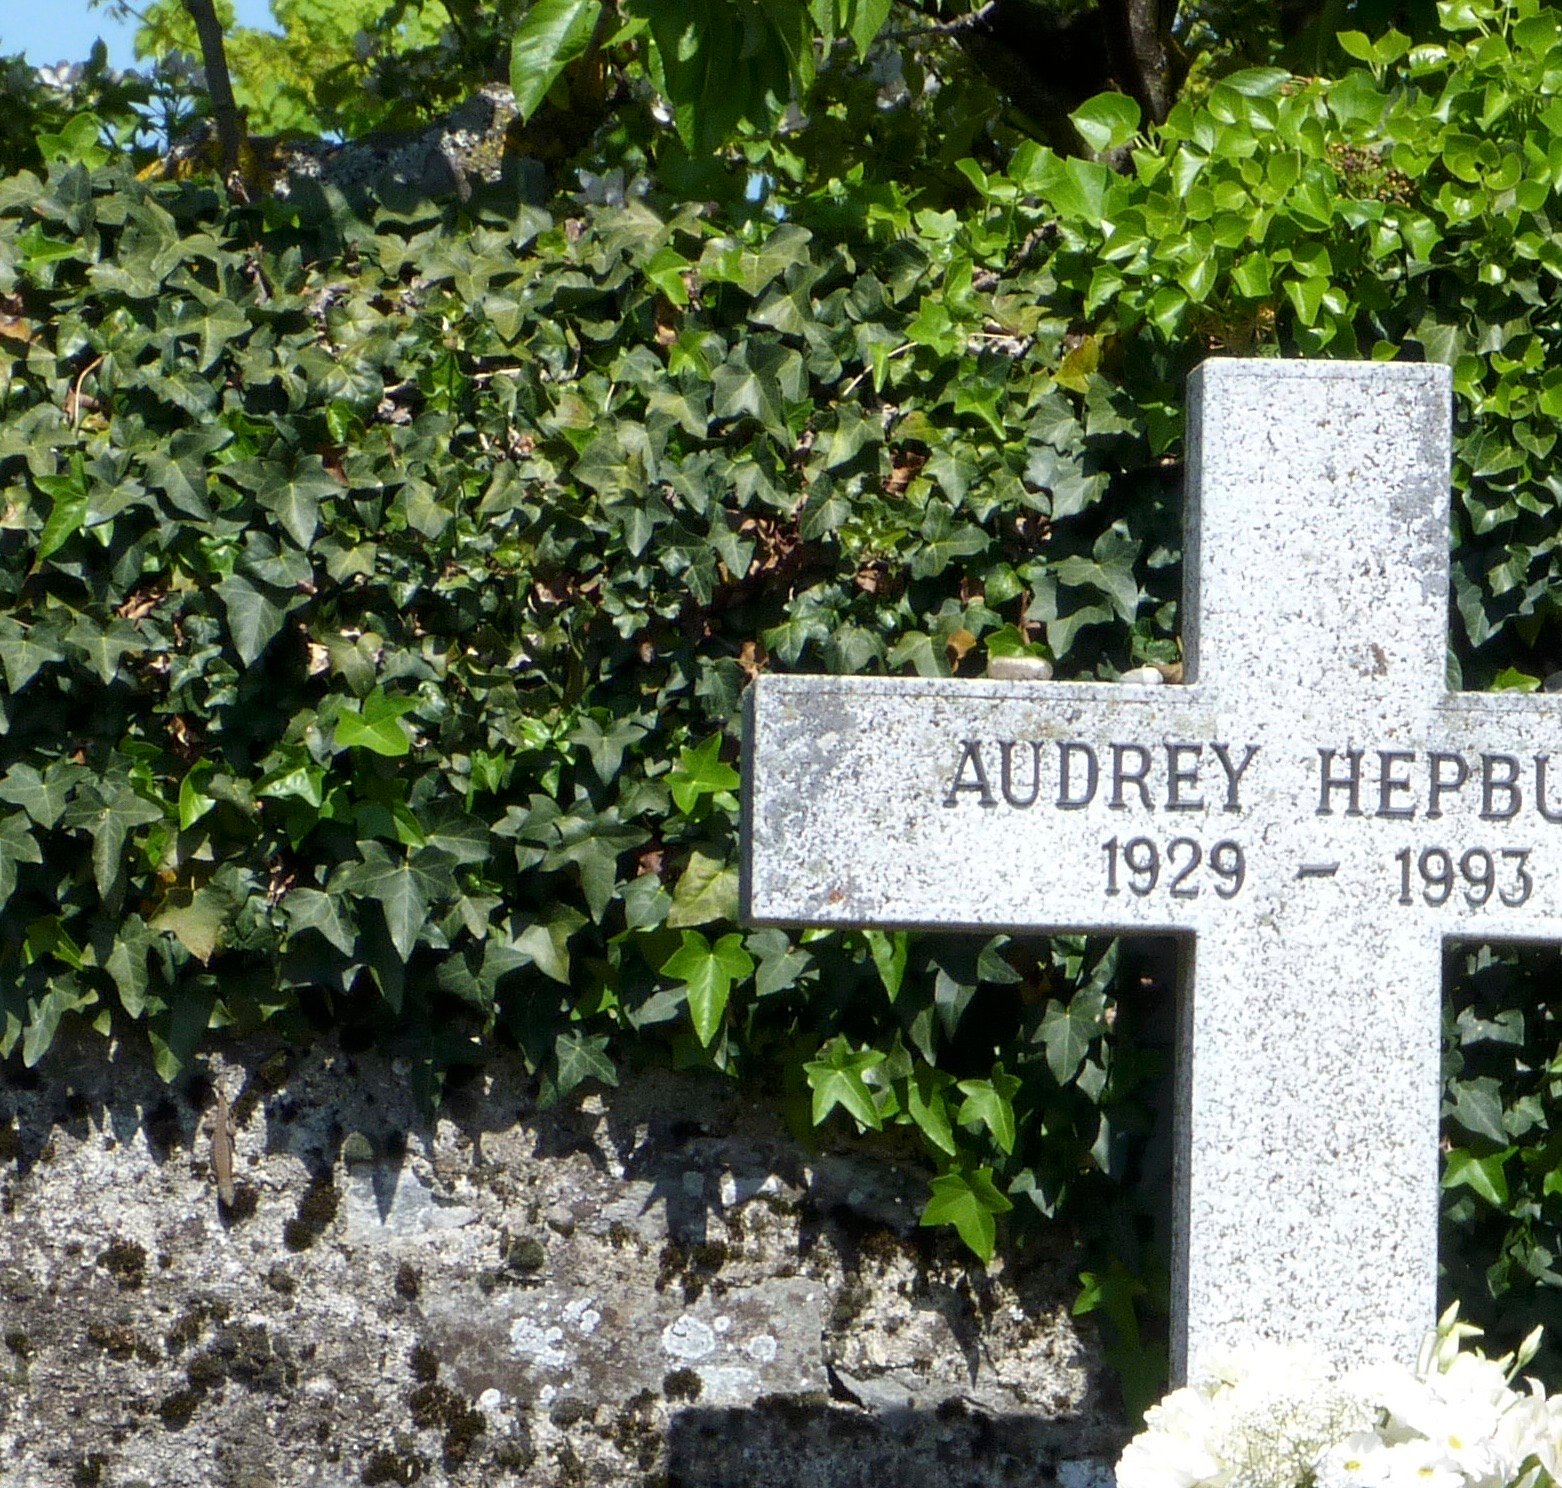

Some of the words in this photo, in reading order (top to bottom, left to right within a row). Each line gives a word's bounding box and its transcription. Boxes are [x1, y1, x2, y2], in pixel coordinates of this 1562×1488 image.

[943, 740, 1261, 812] AUDREY
[1102, 835, 1247, 899] 1929
[1395, 845, 1534, 907] 1993
